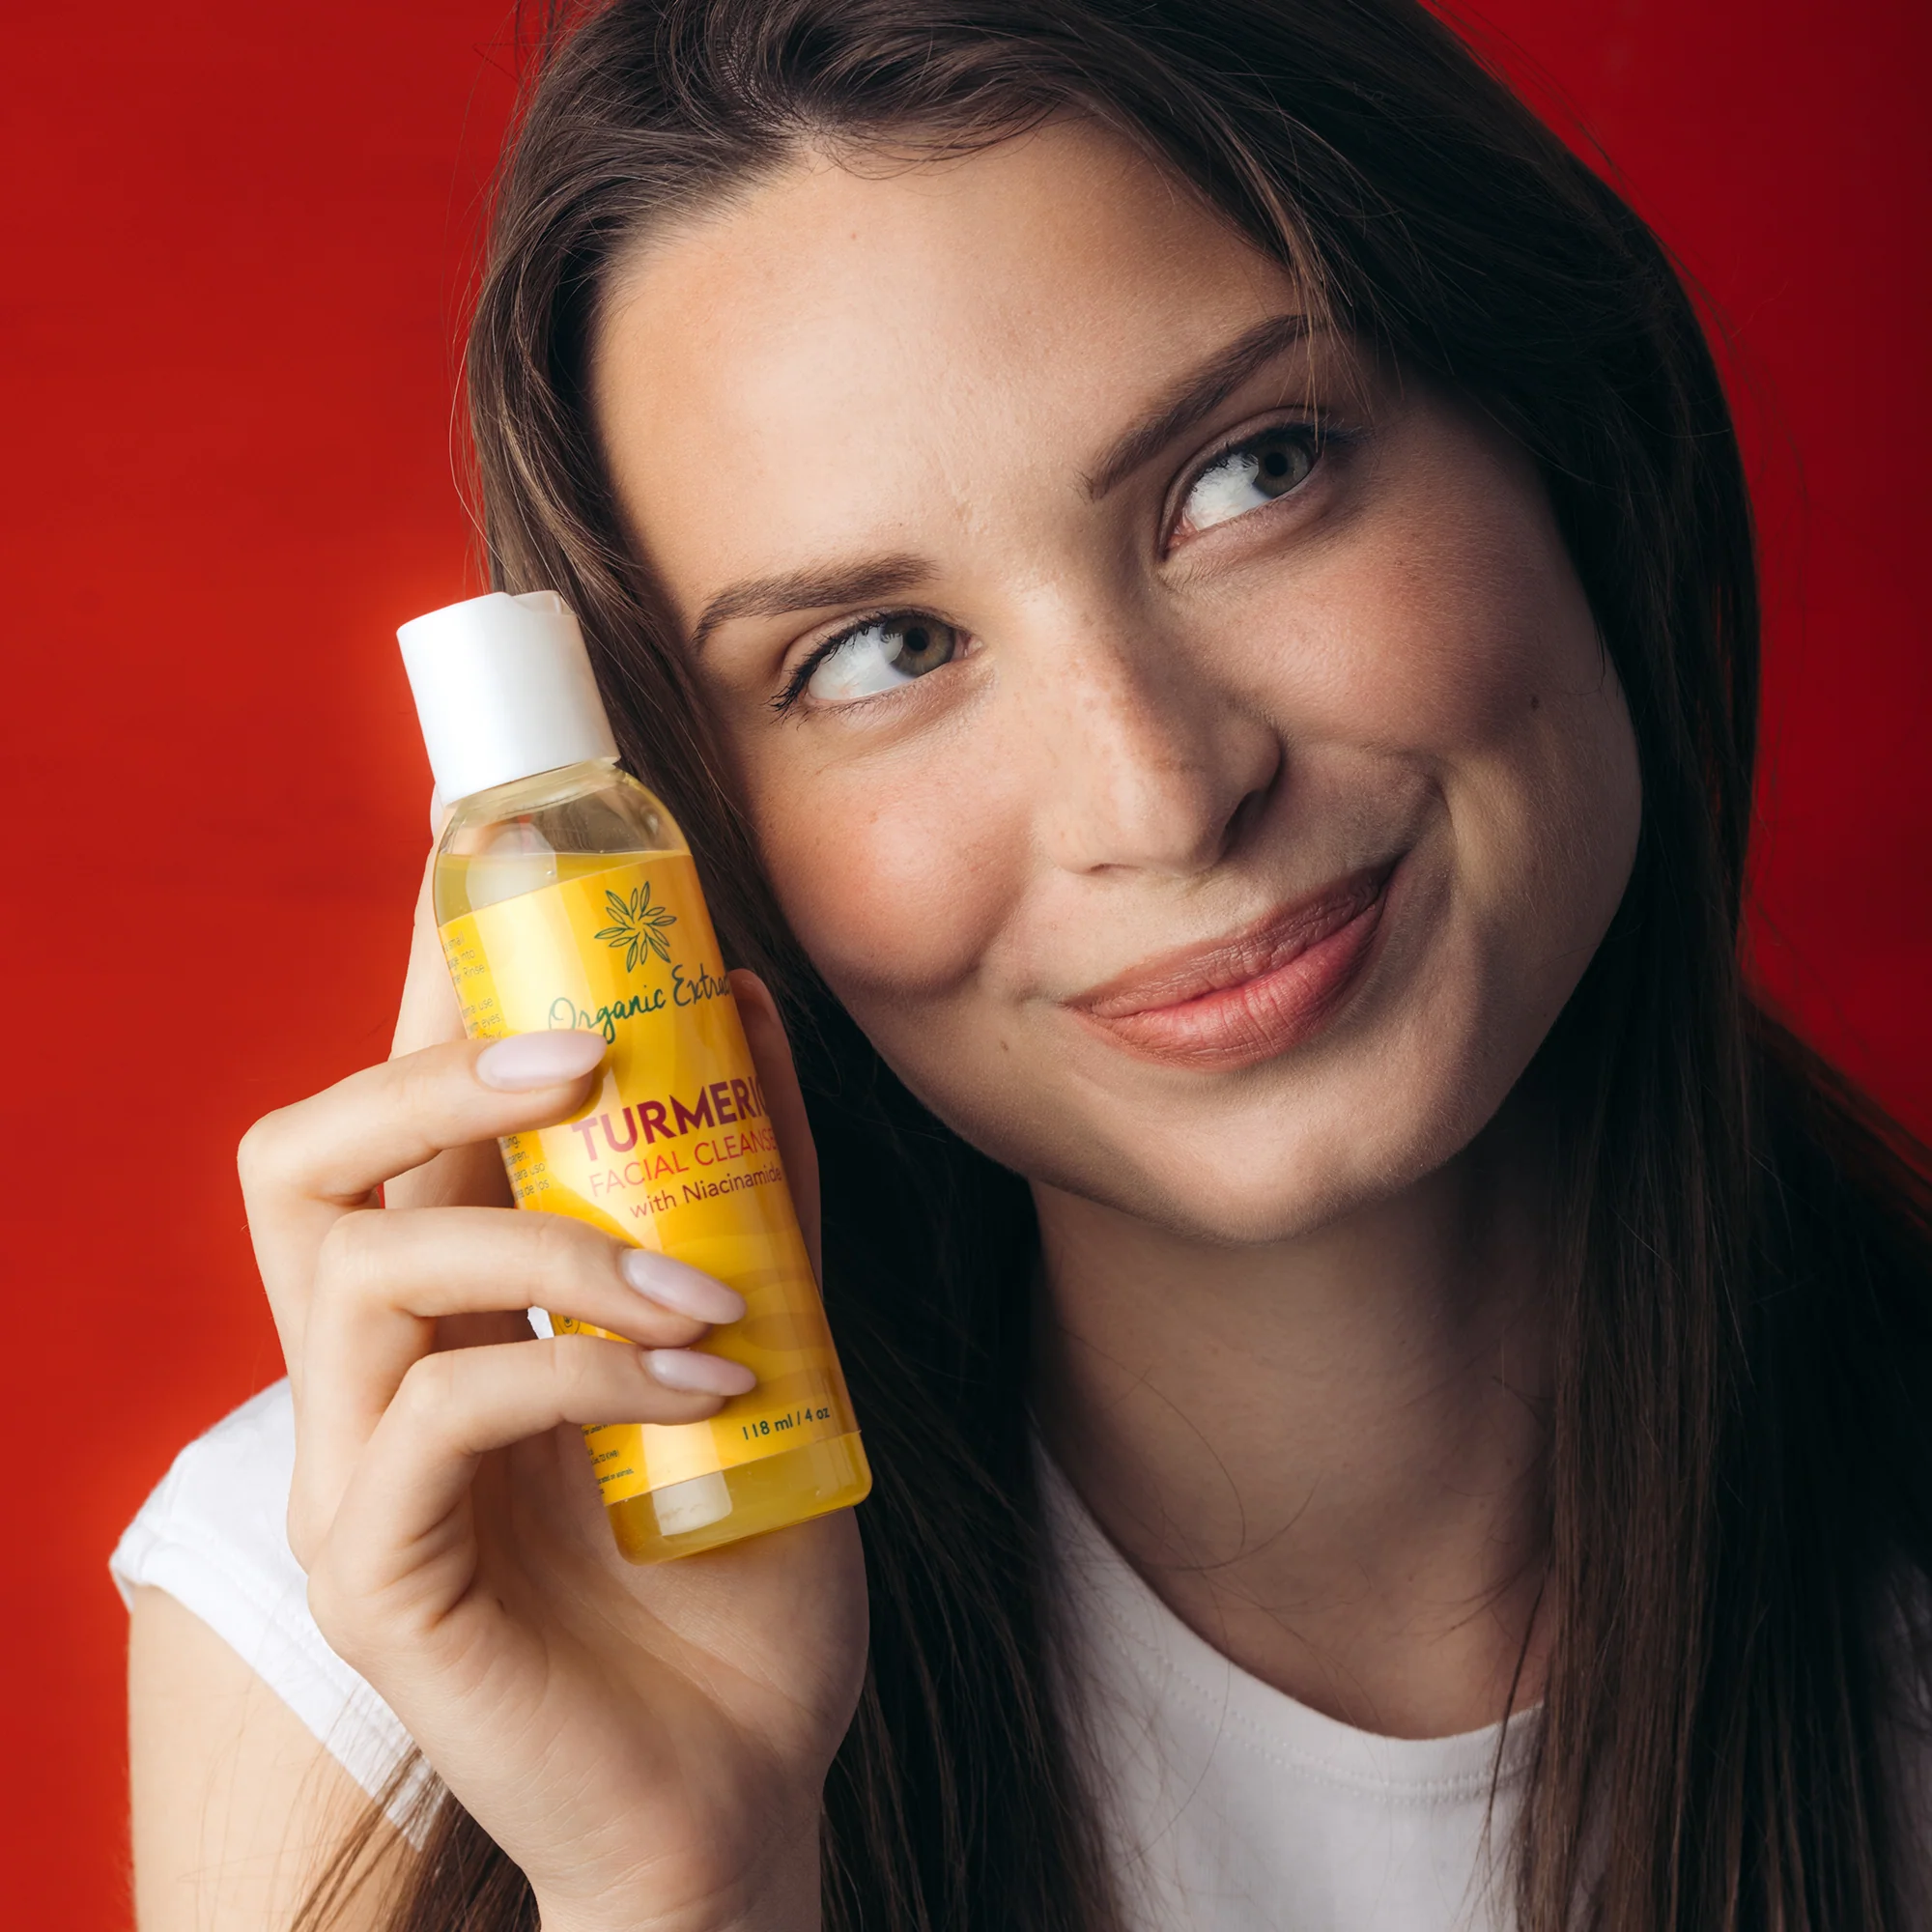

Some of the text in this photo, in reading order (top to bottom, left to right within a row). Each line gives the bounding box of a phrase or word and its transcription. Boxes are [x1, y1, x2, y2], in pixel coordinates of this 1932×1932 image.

[548, 984, 667, 1044] Organic
[588, 1151, 690, 1198] FACIAL
[629, 1161, 782, 1219] with Niacinamide
[742, 1407, 831, 1440] 118 ml / 4 oz
